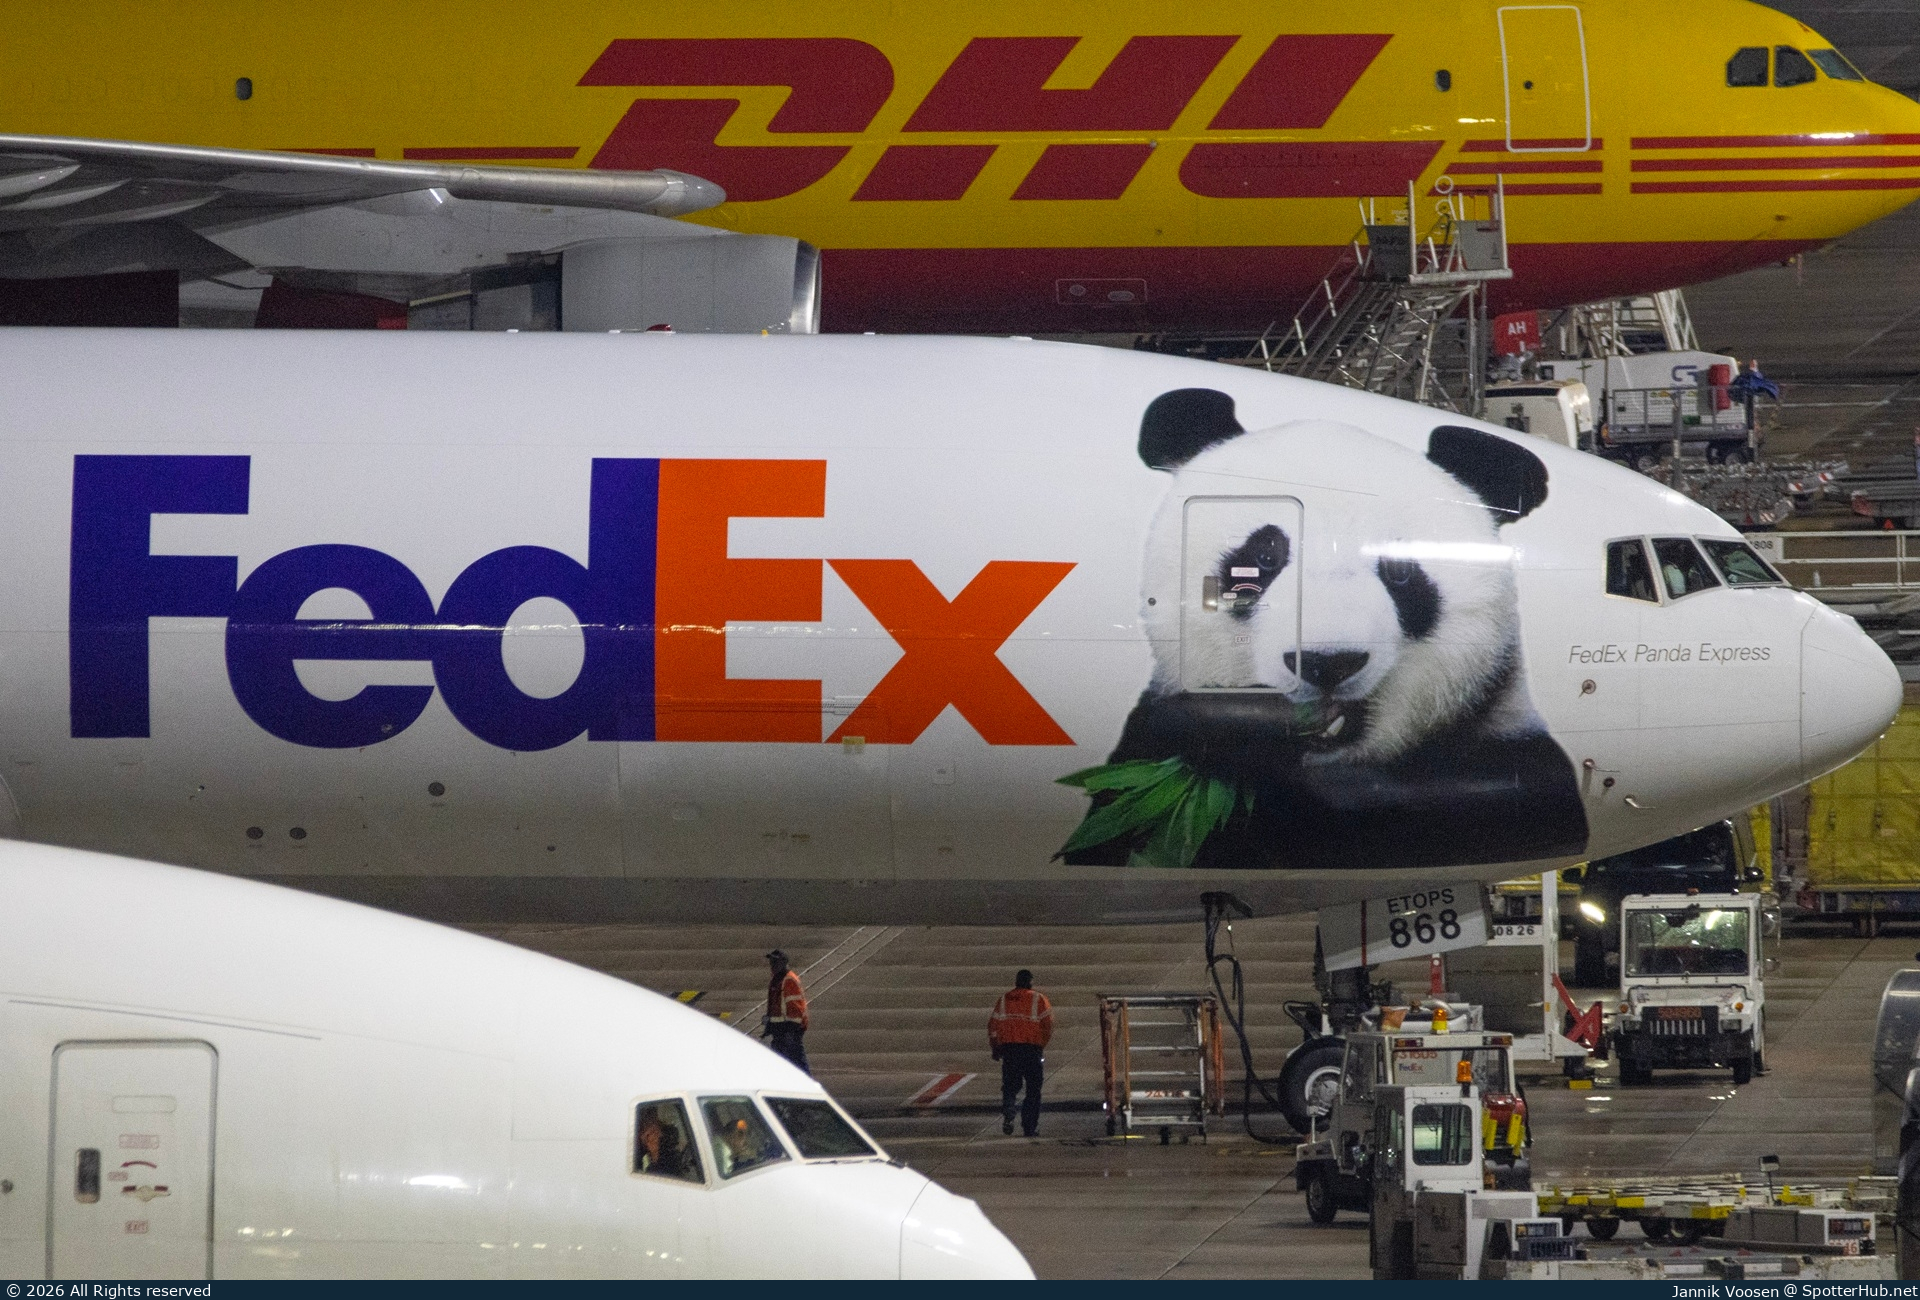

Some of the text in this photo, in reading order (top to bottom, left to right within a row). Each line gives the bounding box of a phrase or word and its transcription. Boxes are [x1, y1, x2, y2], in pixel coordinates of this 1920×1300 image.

[576, 33, 1443, 201] DHL
[1508, 321, 1527, 335] AH
[1749, 540, 1773, 549] 808
[70, 455, 1077, 752] FedEx
[1568, 643, 1771, 665] FedEx Panda Express
[1386, 888, 1454, 914] ETOPS
[1389, 909, 1461, 948] 868
